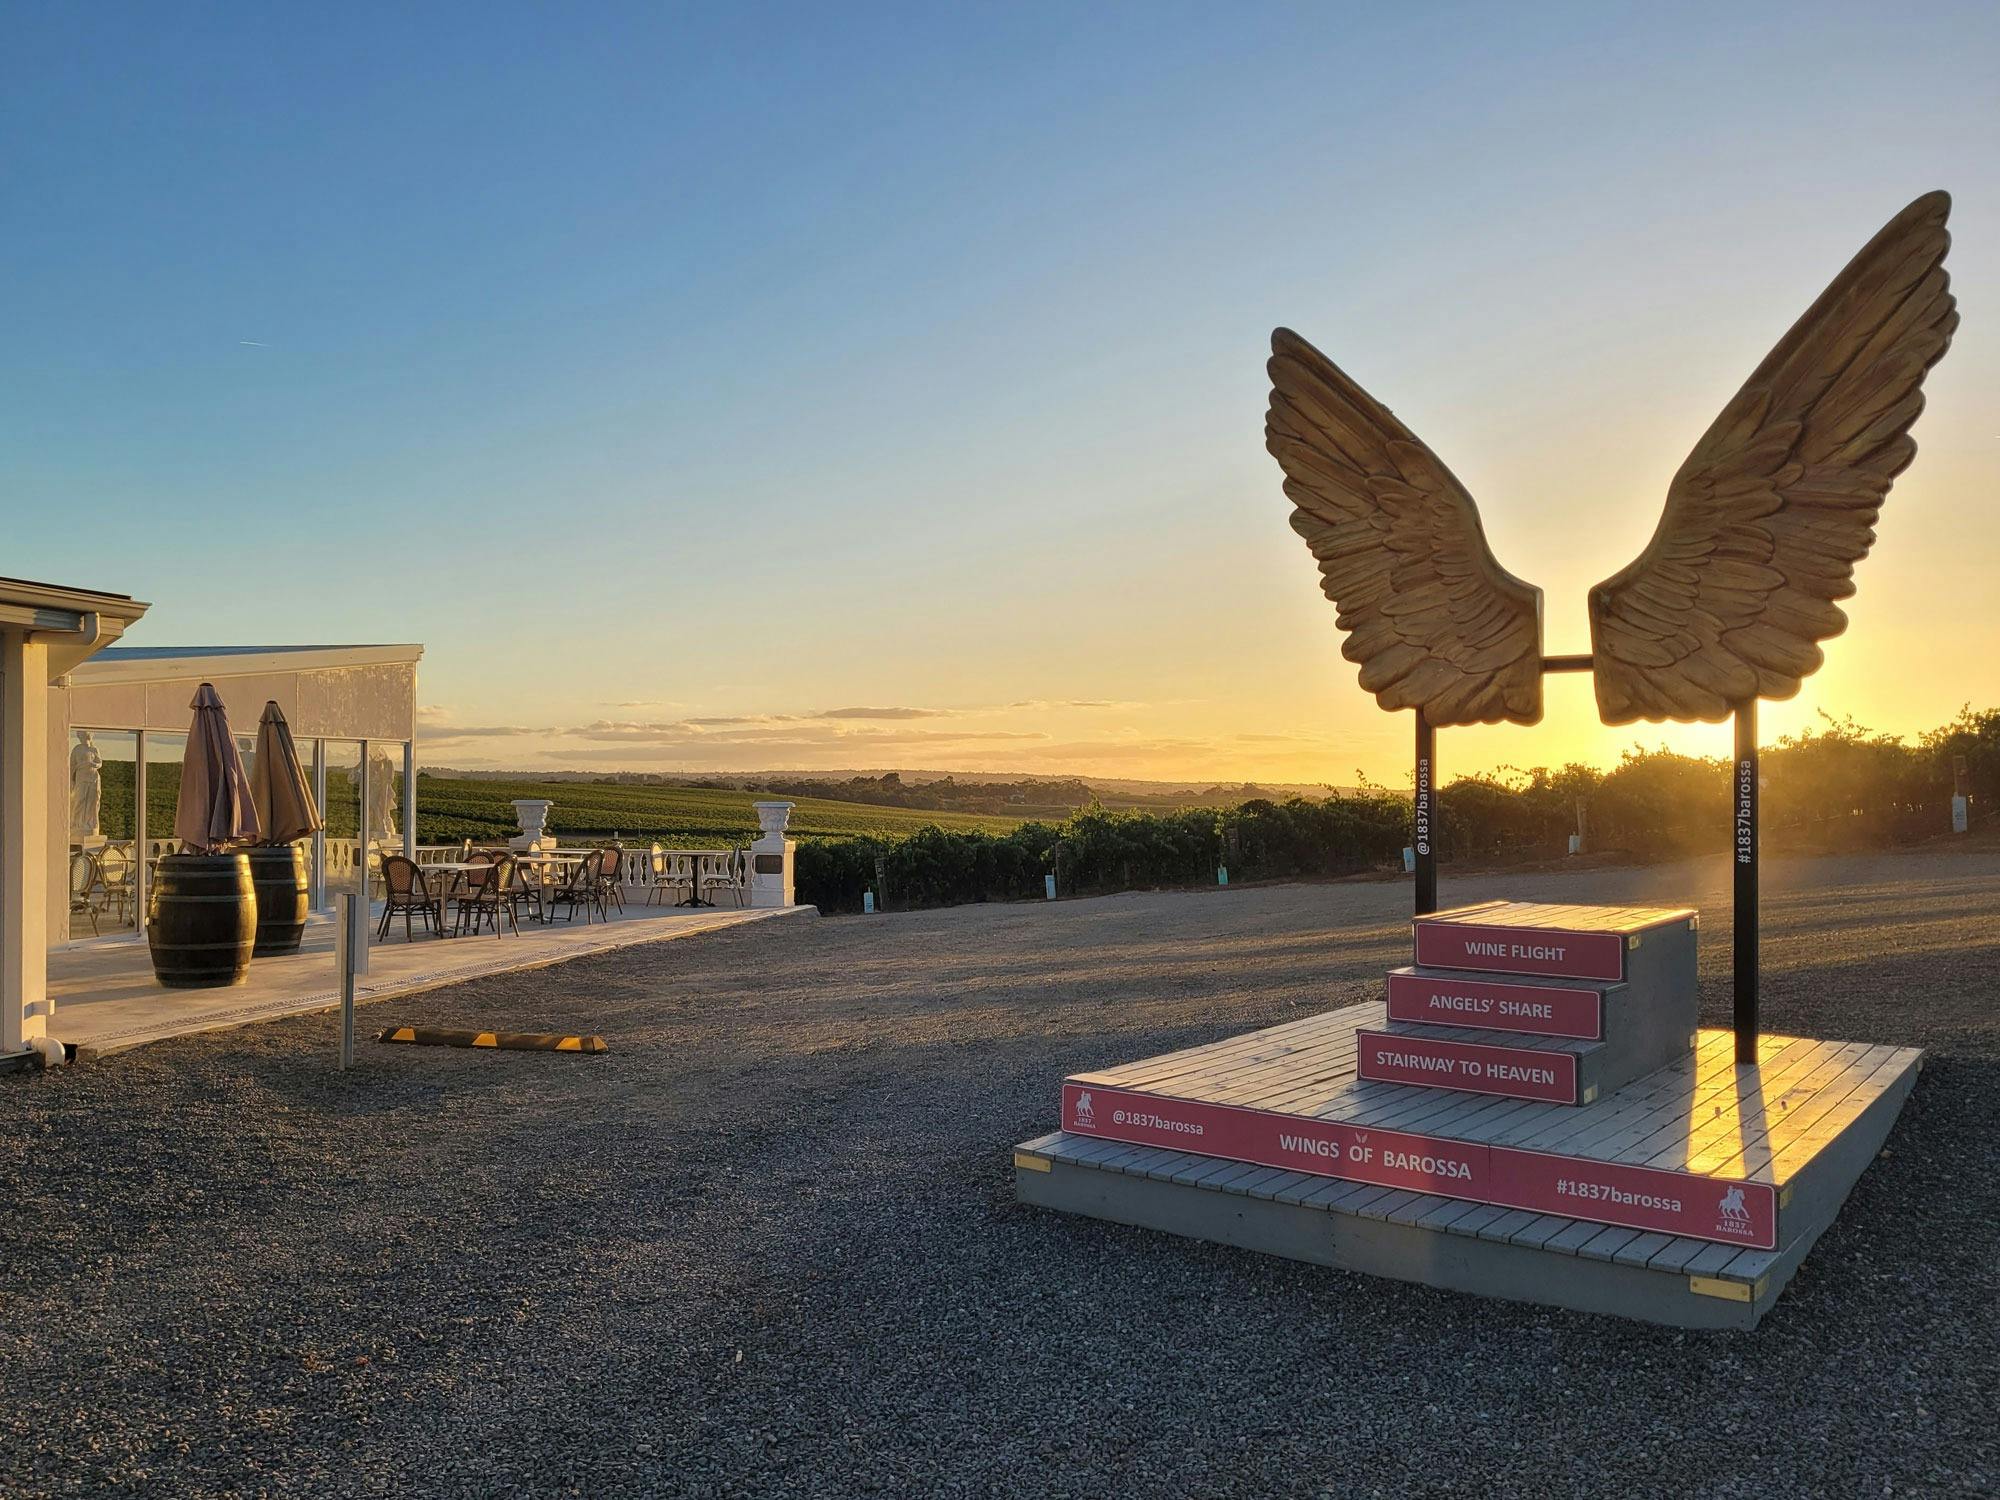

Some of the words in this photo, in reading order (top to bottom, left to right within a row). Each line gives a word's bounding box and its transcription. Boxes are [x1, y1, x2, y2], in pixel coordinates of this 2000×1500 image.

[1417, 759, 1430, 855] @1837barossa
[1737, 760, 1751, 864] #1837barossa
[1465, 941, 1506, 957] WINE
[1511, 945, 1566, 961] FLIGHT
[1499, 1001, 1553, 1018] SHARE
[1376, 1051, 1455, 1073] STAIRWAY
[1460, 1061, 1482, 1076] TO
[1486, 1064, 1555, 1085] HEAVEN
[1112, 1110, 1204, 1136] @1837barossa
[1279, 1134, 1340, 1158] WINGS
[1349, 1145, 1374, 1164] OF
[1383, 1151, 1473, 1181] BAROSSA
[1556, 1179, 1682, 1213] #1837barossa
[1724, 1220, 1746, 1229] 1837
